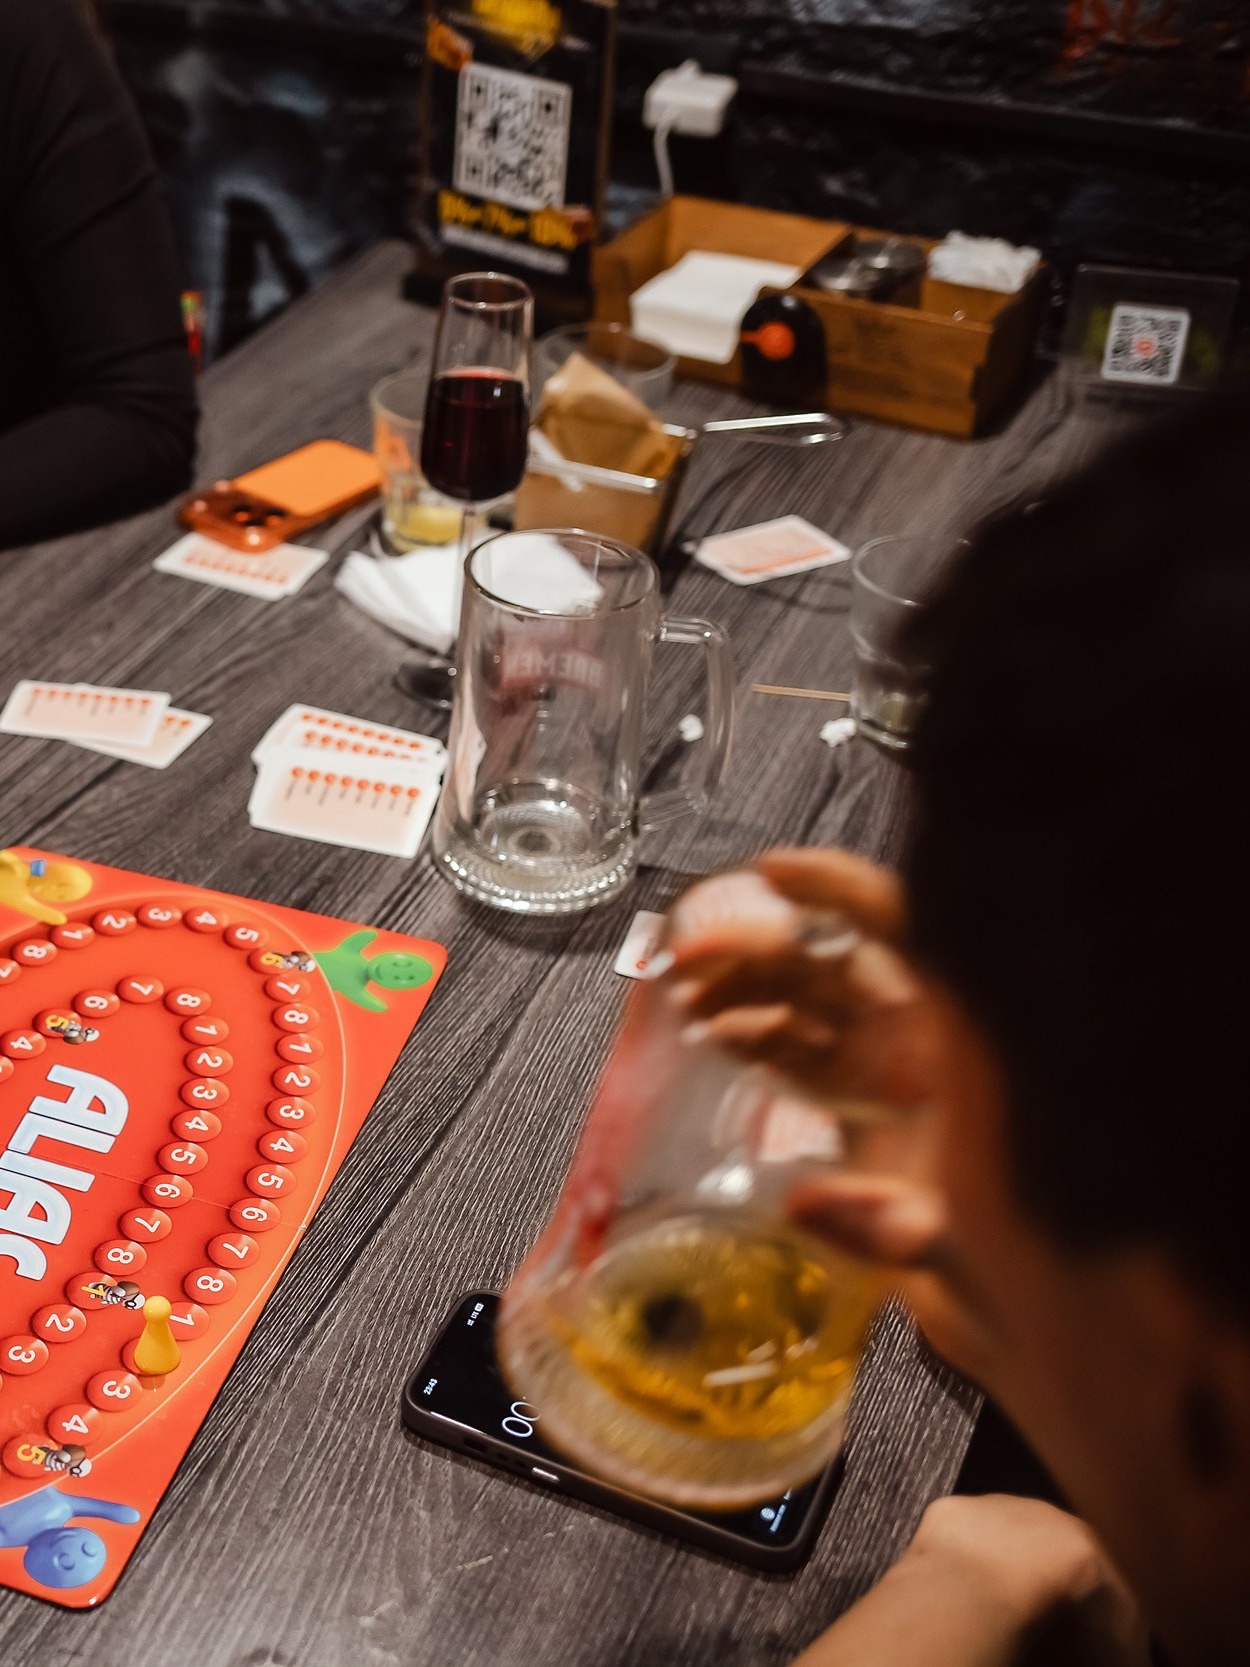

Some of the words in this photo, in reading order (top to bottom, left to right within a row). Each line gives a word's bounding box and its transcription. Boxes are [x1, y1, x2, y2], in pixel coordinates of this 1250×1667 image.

[103, 916, 126, 928] 2
[149, 909, 171, 921] 3
[196, 912, 217, 924] 4
[63, 928, 85, 940] 1
[236, 928, 259, 941] 5
[24, 945, 46, 958] 8
[261, 952, 283, 965] 6
[131, 983, 154, 995] 7
[277, 982, 300, 995] 7
[85, 996, 108, 1009] 6
[177, 994, 201, 1007] 8
[46, 1016, 70, 1031] 5
[285, 1010, 309, 1023] 8
[196, 1025, 217, 1034] 1
[11, 1036, 33, 1050] 4
[290, 1041, 312, 1053] 1
[197, 1053, 223, 1067] 2
[285, 1072, 311, 1087] 2
[193, 1085, 217, 1100] 3
[280, 1106, 304, 1119] 3
[185, 1116, 209, 1131] 4
[270, 1138, 294, 1152] 4
[171, 1149, 196, 1165] 5
[258, 1173, 283, 1188] 5
[155, 1184, 180, 1198] 6
[242, 1207, 267, 1221] 6
[135, 1216, 160, 1232] 7
[108, 1248, 134, 1264] 8
[223, 1243, 249, 1258] 7
[82, 1284, 105, 1298] 1
[197, 1276, 223, 1292] 8
[46, 1314, 74, 1331] 2
[169, 1313, 193, 1325] 1
[9, 1346, 35, 1362] 3
[103, 1381, 130, 1398] 3
[62, 1415, 88, 1433] 4
[17, 1445, 45, 1464] 5
